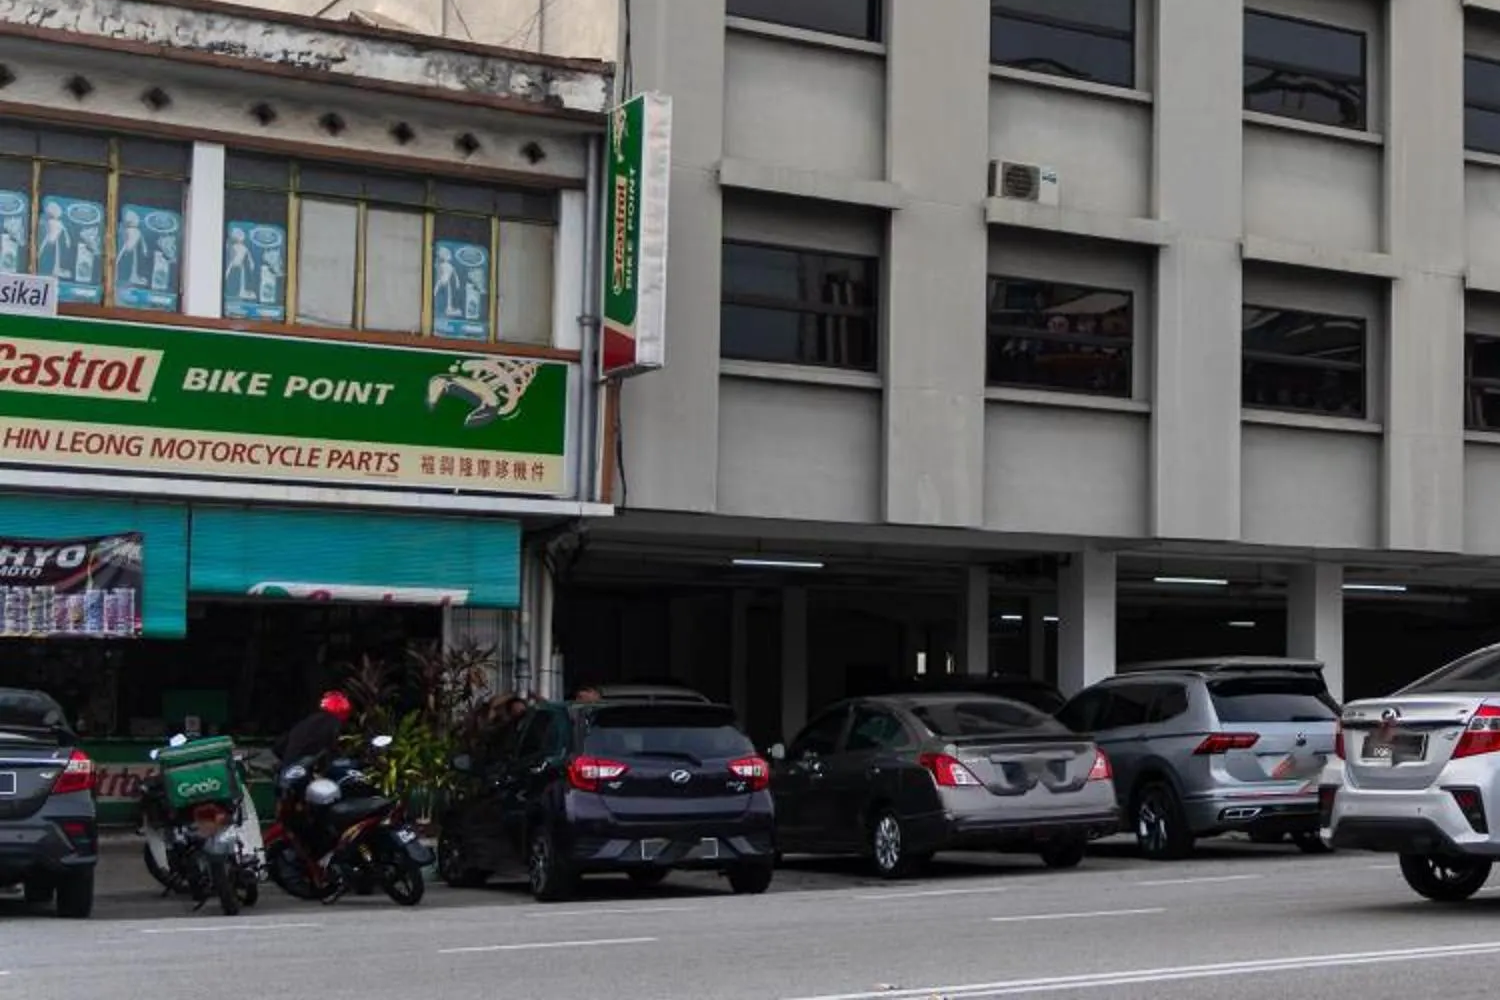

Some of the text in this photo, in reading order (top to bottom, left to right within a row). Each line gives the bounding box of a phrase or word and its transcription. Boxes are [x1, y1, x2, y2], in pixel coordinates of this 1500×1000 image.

[627, 166, 636, 231] POINT
[0, 343, 147, 393] Castrol
[182, 367, 395, 405] BIKE POINT
[3, 427, 400, 473] HIN LEONG MOTORCYCLE PARTS
[177, 777, 221, 797] Grab
